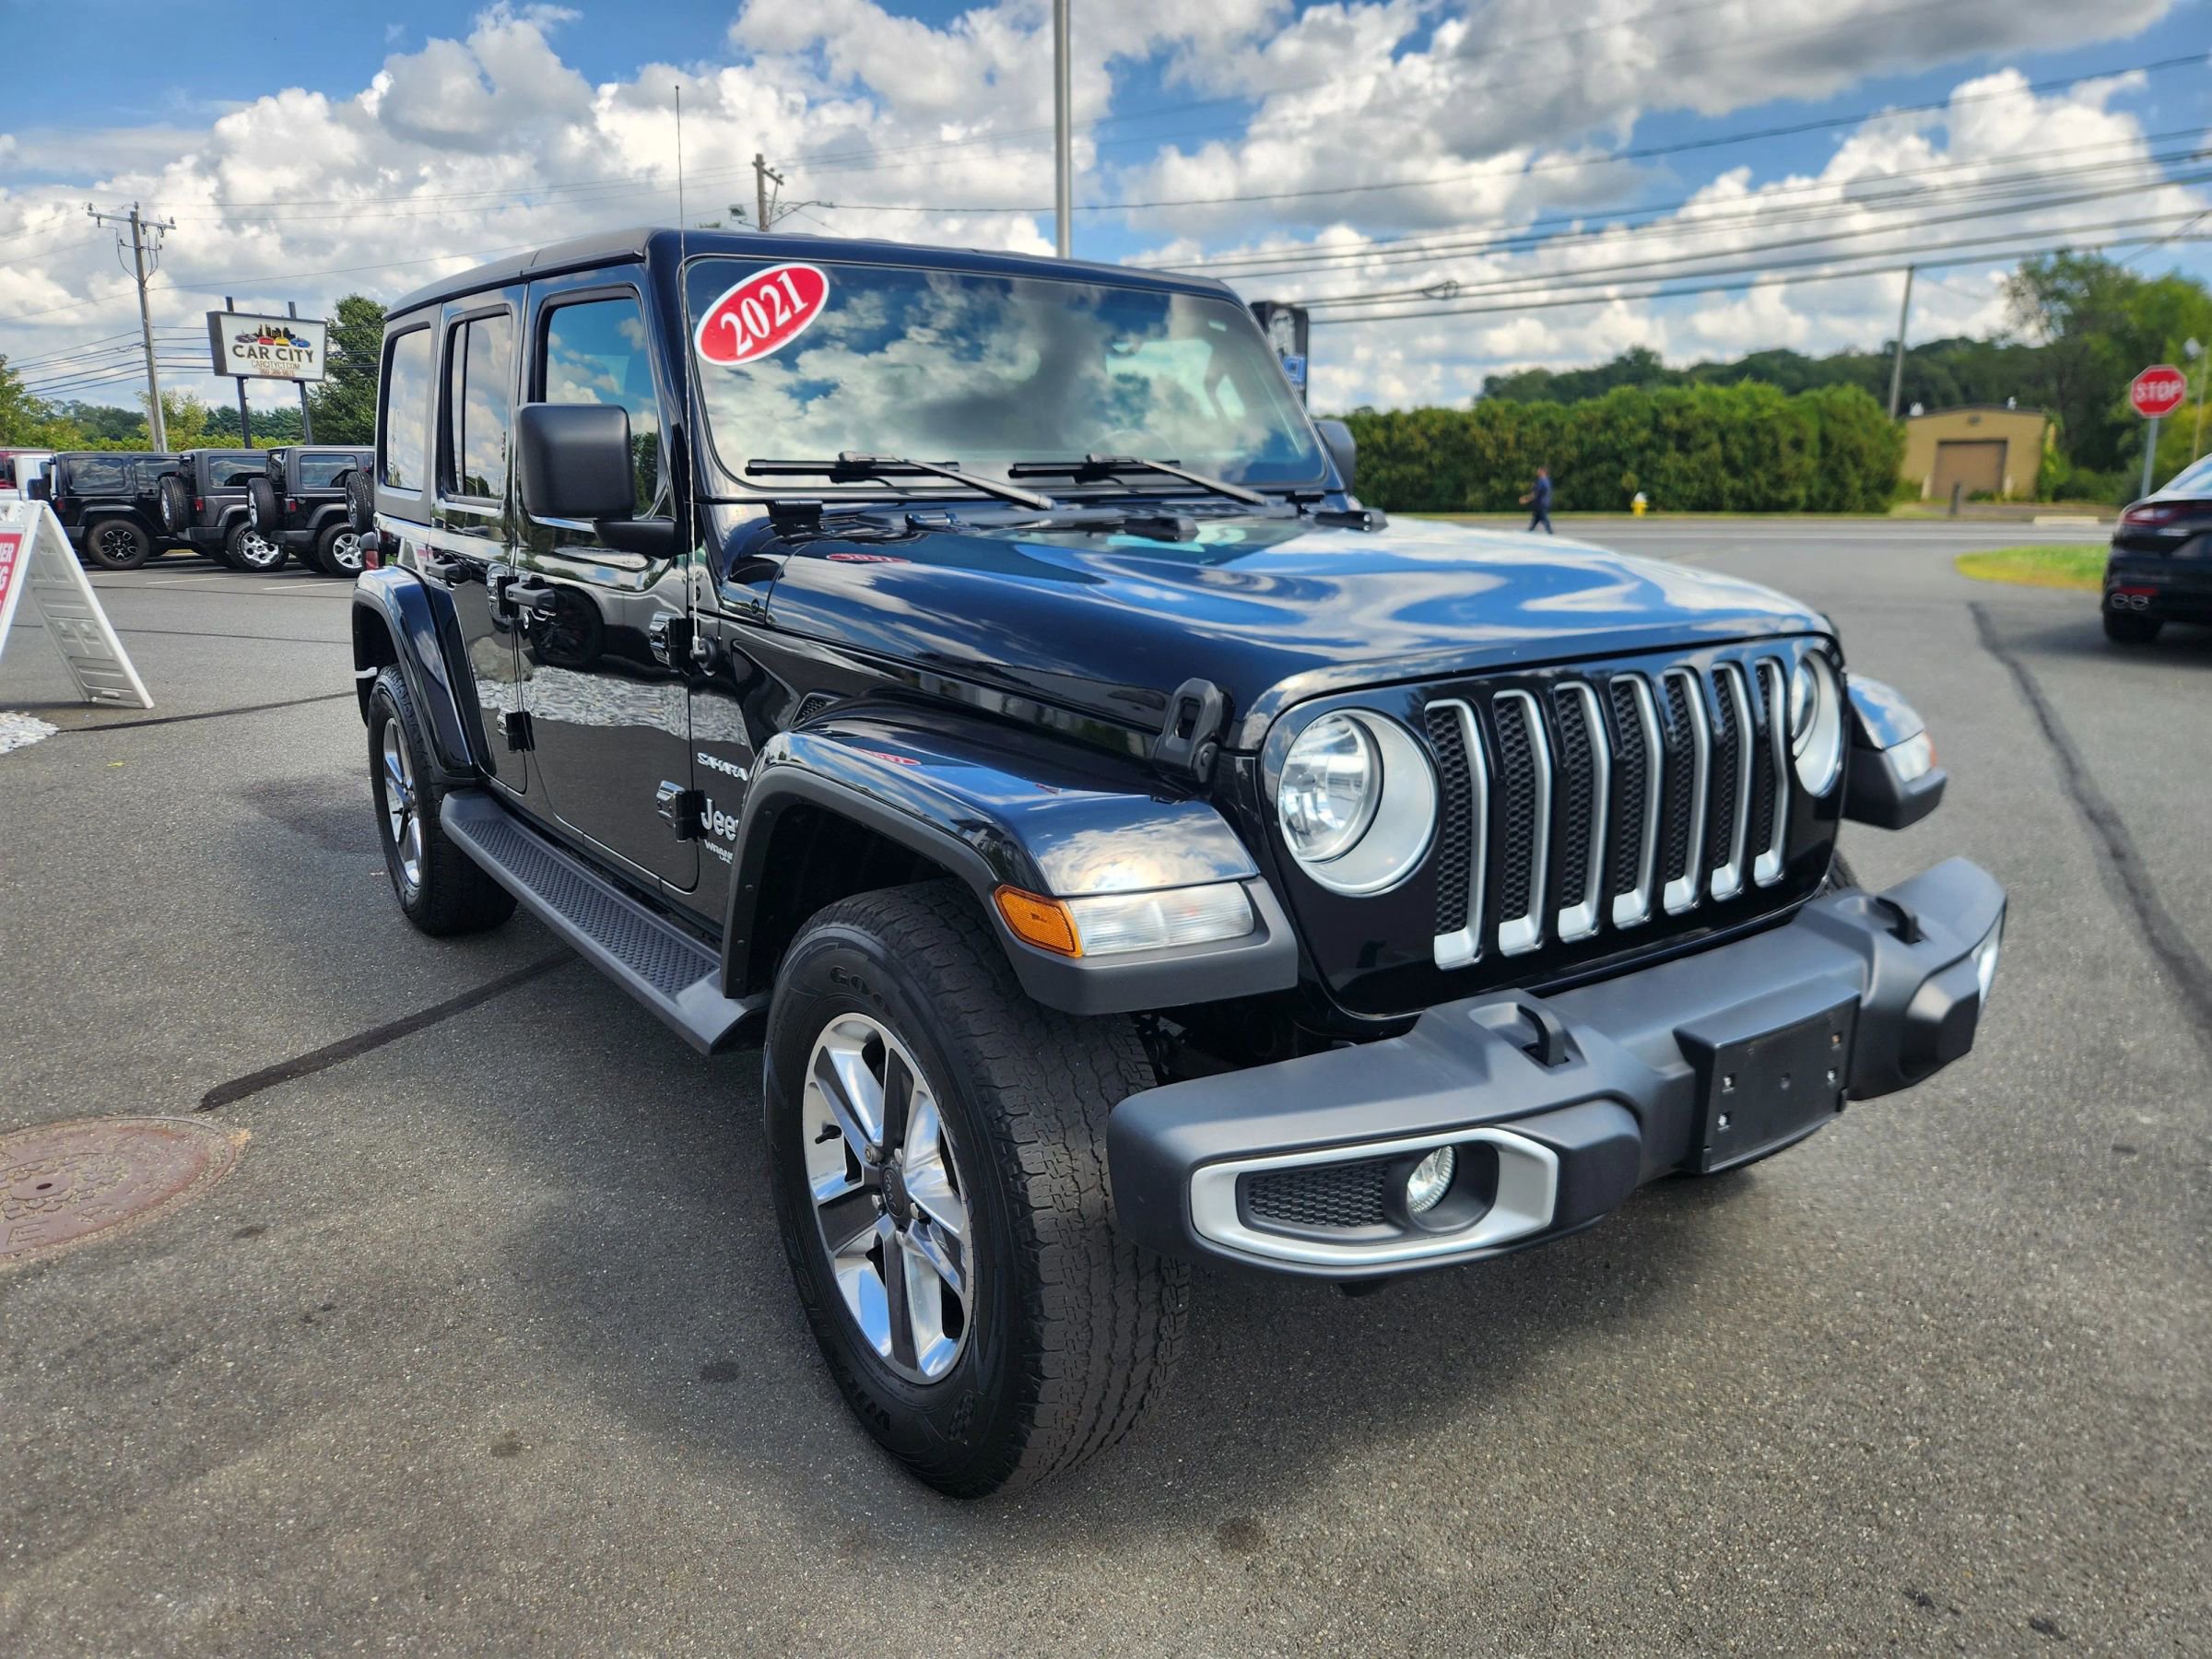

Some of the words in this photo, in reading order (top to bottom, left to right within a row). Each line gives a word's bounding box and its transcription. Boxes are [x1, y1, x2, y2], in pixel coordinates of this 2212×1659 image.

[721, 270, 808, 357] 2021
[232, 344, 270, 359] CAR
[276, 347, 314, 363] CITY
[2136, 380, 2182, 403] STOP
[697, 752, 748, 782] SAHARA
[700, 798, 739, 841] Jee
